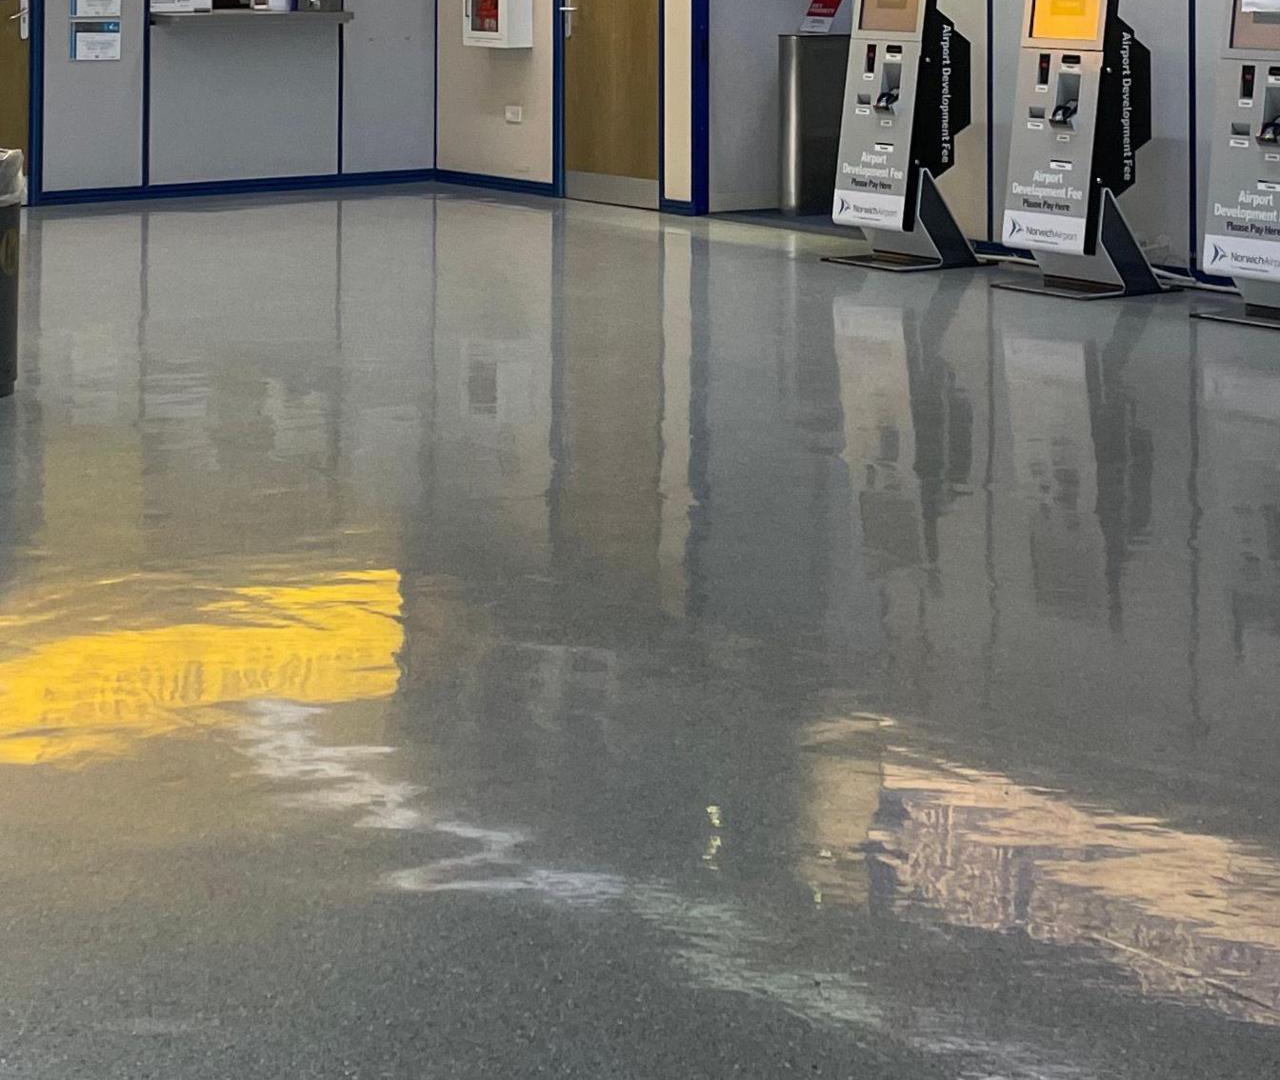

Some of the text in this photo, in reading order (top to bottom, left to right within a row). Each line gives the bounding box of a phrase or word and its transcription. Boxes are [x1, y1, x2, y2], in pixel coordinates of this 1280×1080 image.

[939, 24, 953, 164] Airport Development Fee
[1120, 32, 1132, 181] Airport Development Fee
[1033, 170, 1063, 184] Airport
[1238, 190, 1273, 207] Airport
[1214, 203, 1277, 221] Development
[1250, 223, 1264, 235] Pay
